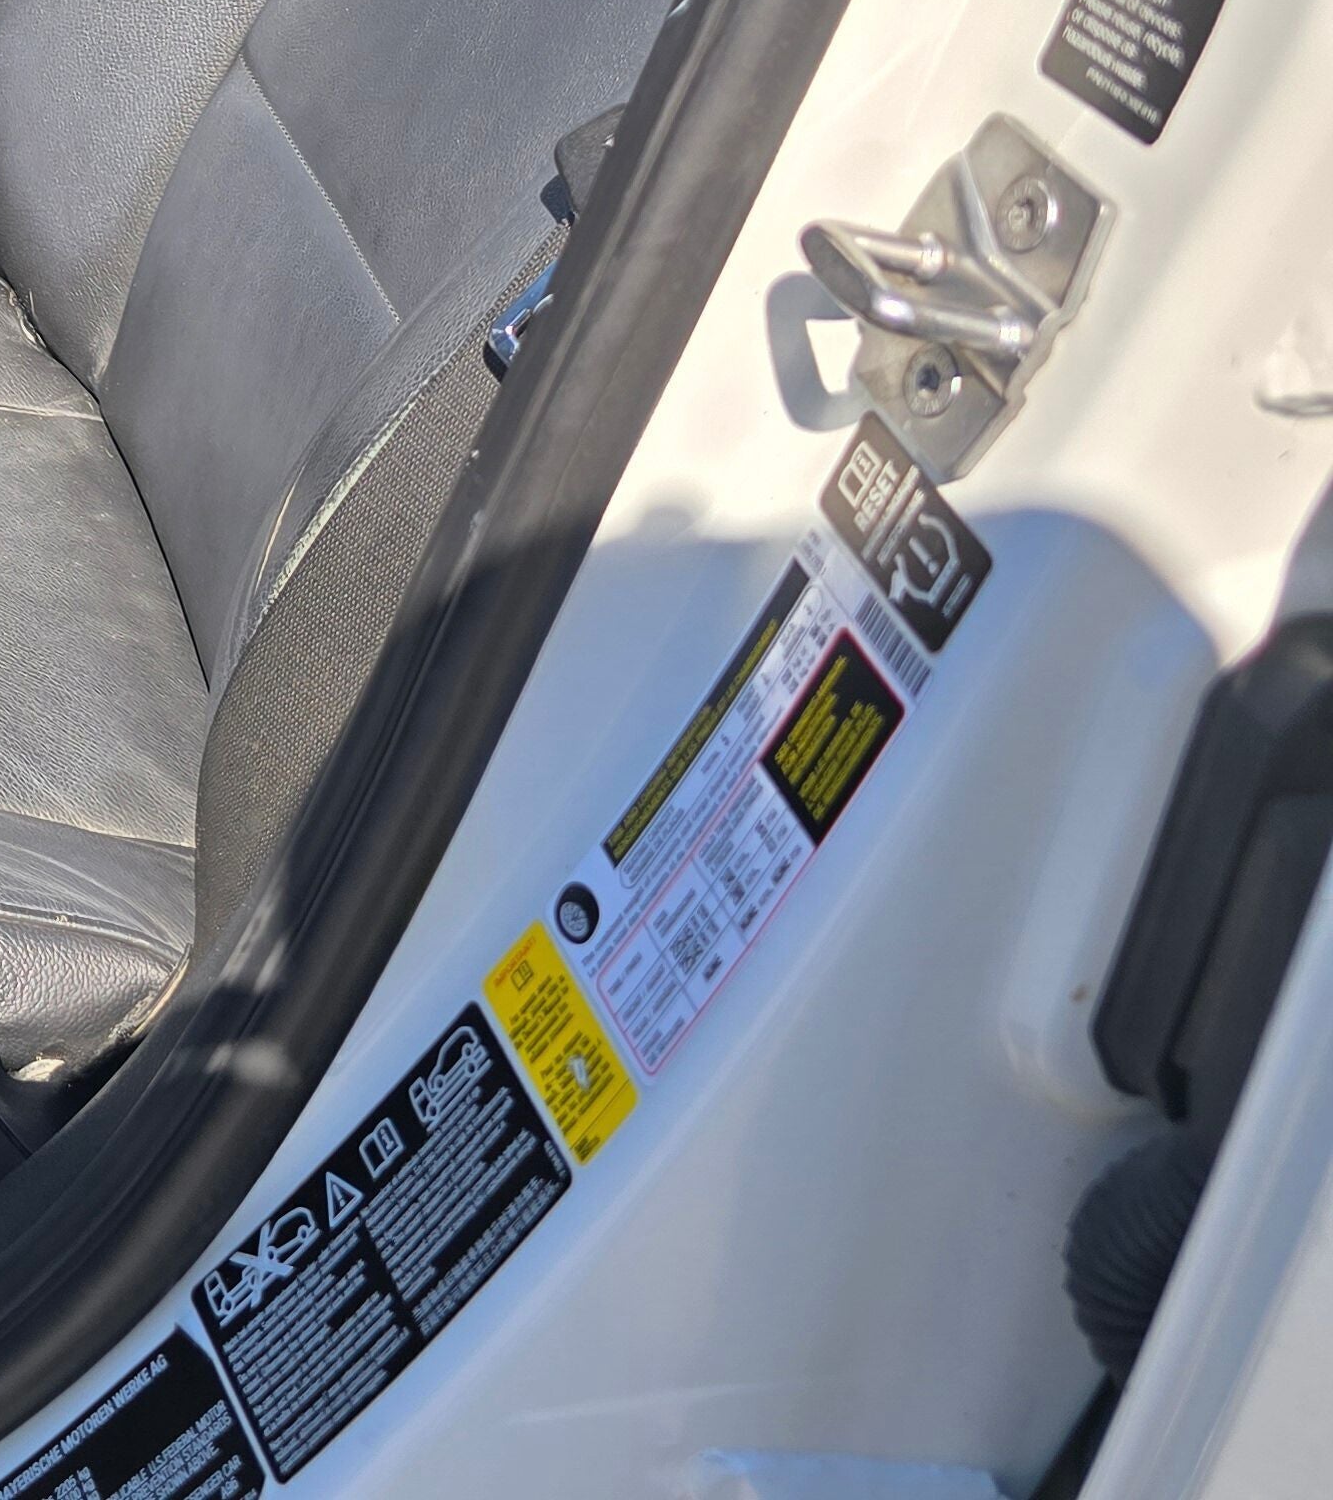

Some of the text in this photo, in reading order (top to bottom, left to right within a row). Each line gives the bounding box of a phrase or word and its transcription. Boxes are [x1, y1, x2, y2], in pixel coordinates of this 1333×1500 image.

[852, 457, 900, 534] RESET
[55, 1398, 117, 1454] MOTOREN
[108, 1365, 154, 1408] WERKE
[145, 1351, 170, 1377] AG
[193, 1399, 228, 1432] MOTOR
[178, 1411, 234, 1462] STANDARDS
[50, 1462, 93, 1500] 2205 kg
[153, 1466, 190, 1500] SHOWN
[219, 1453, 243, 1477] CAR
